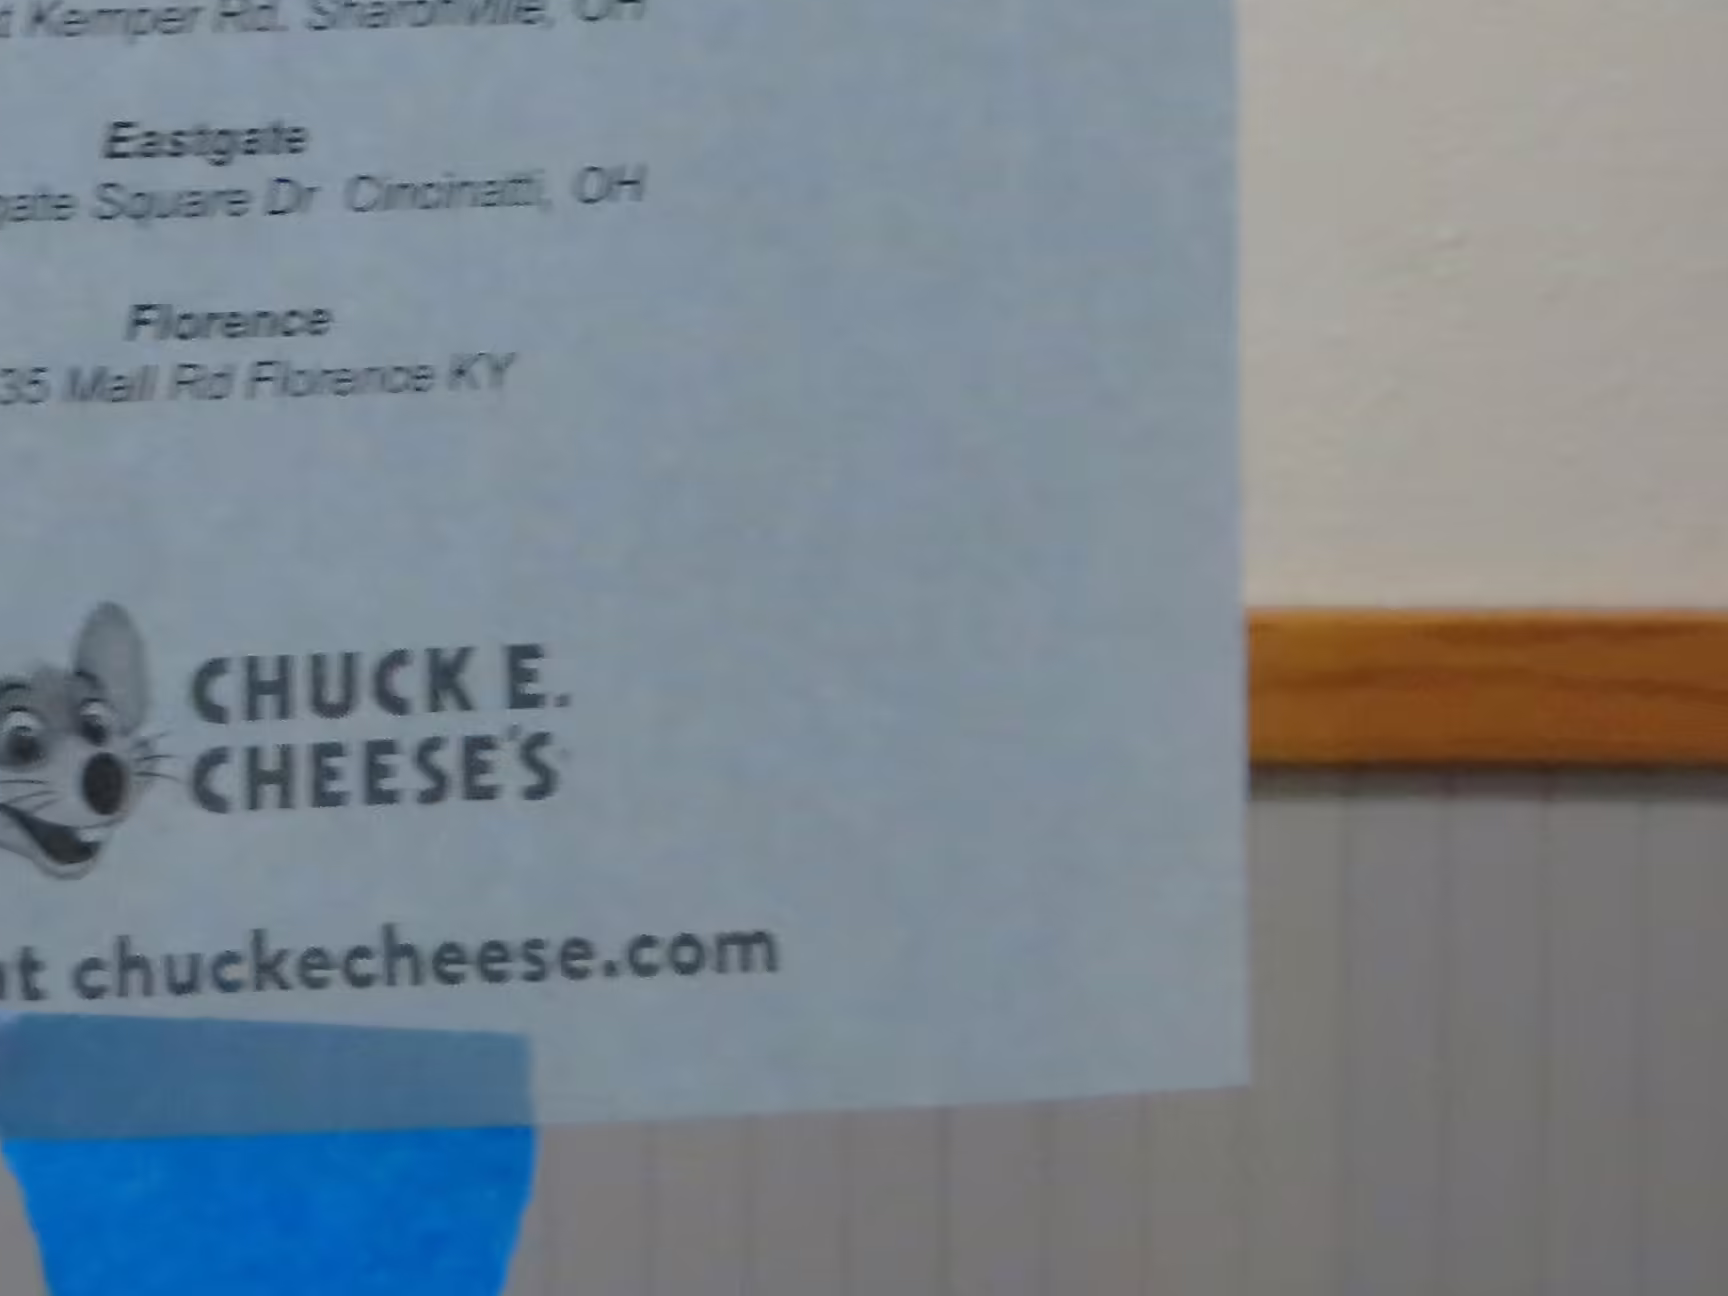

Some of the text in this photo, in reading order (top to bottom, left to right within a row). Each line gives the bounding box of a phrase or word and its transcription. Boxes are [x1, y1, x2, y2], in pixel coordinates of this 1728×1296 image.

[22, 0, 202, 46] Kemper
[102, 119, 308, 166] Eastgate
[91, 180, 249, 226] Square
[571, 165, 649, 206] OH
[123, 304, 336, 342] Florence
[56, 365, 160, 404] Mall
[168, 362, 240, 401] Rd
[244, 359, 438, 397] Florence
[442, 351, 520, 392] KY
[190, 643, 574, 724] CHUCK E.
[192, 724, 560, 814] CHEESE'S
[71, 923, 784, 1002] chuckecheese.com
